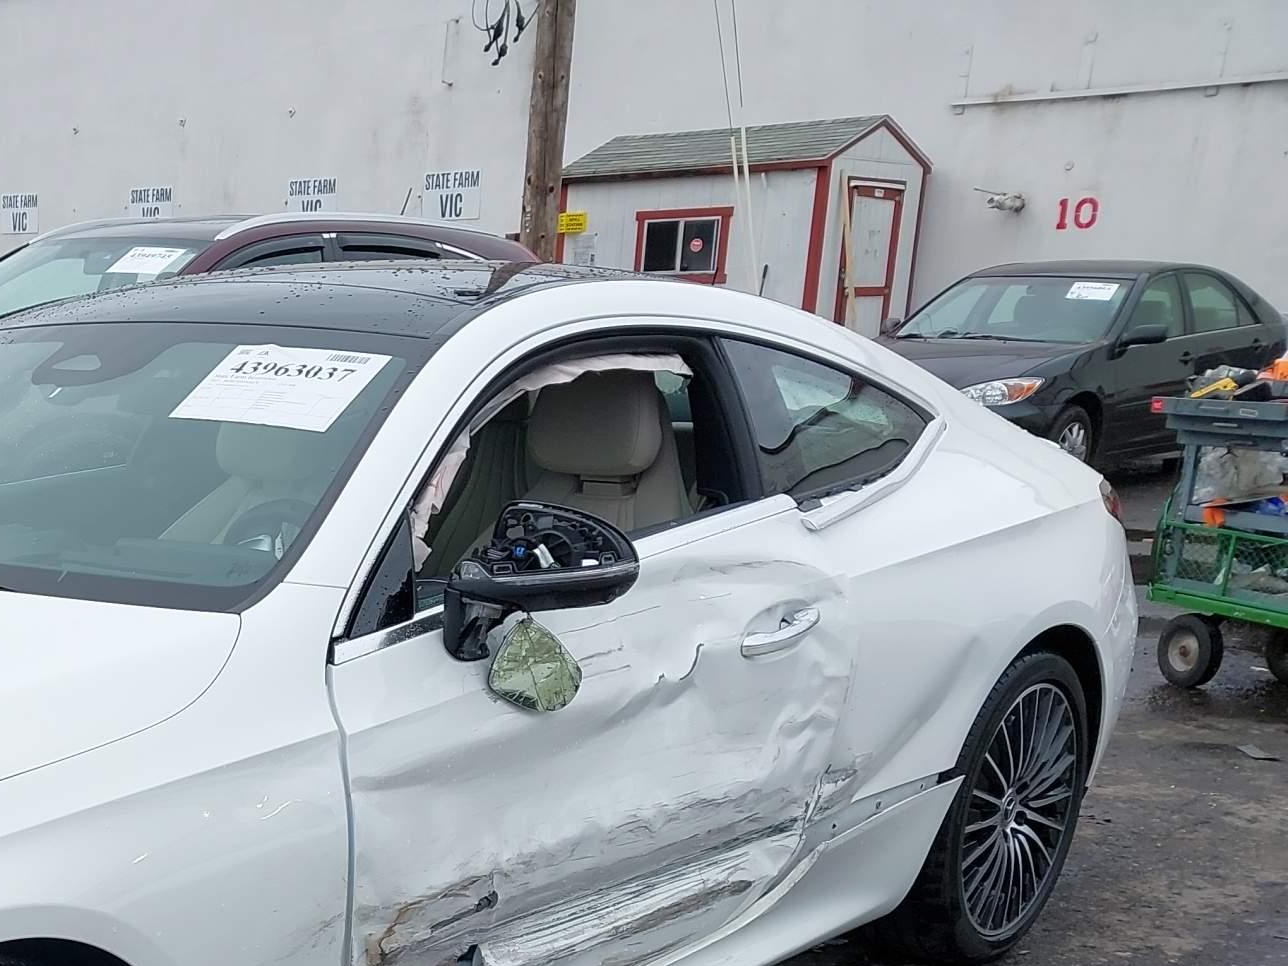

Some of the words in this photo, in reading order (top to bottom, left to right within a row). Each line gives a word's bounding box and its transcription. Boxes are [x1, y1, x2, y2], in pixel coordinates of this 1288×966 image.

[289, 180, 311, 196] STATE
[313, 178, 336, 195] FARM
[425, 172, 451, 190] STATE
[453, 170, 480, 188] FARM
[2, 195, 19, 209] STATE
[20, 194, 38, 209] FARM
[131, 189, 150, 204] STATE
[152, 187, 172, 203] FARM
[440, 193, 463, 218] VIC
[12, 212, 27, 232] VIC
[1056, 197, 1099, 230] 10
[230, 360, 358, 383] 43963037
